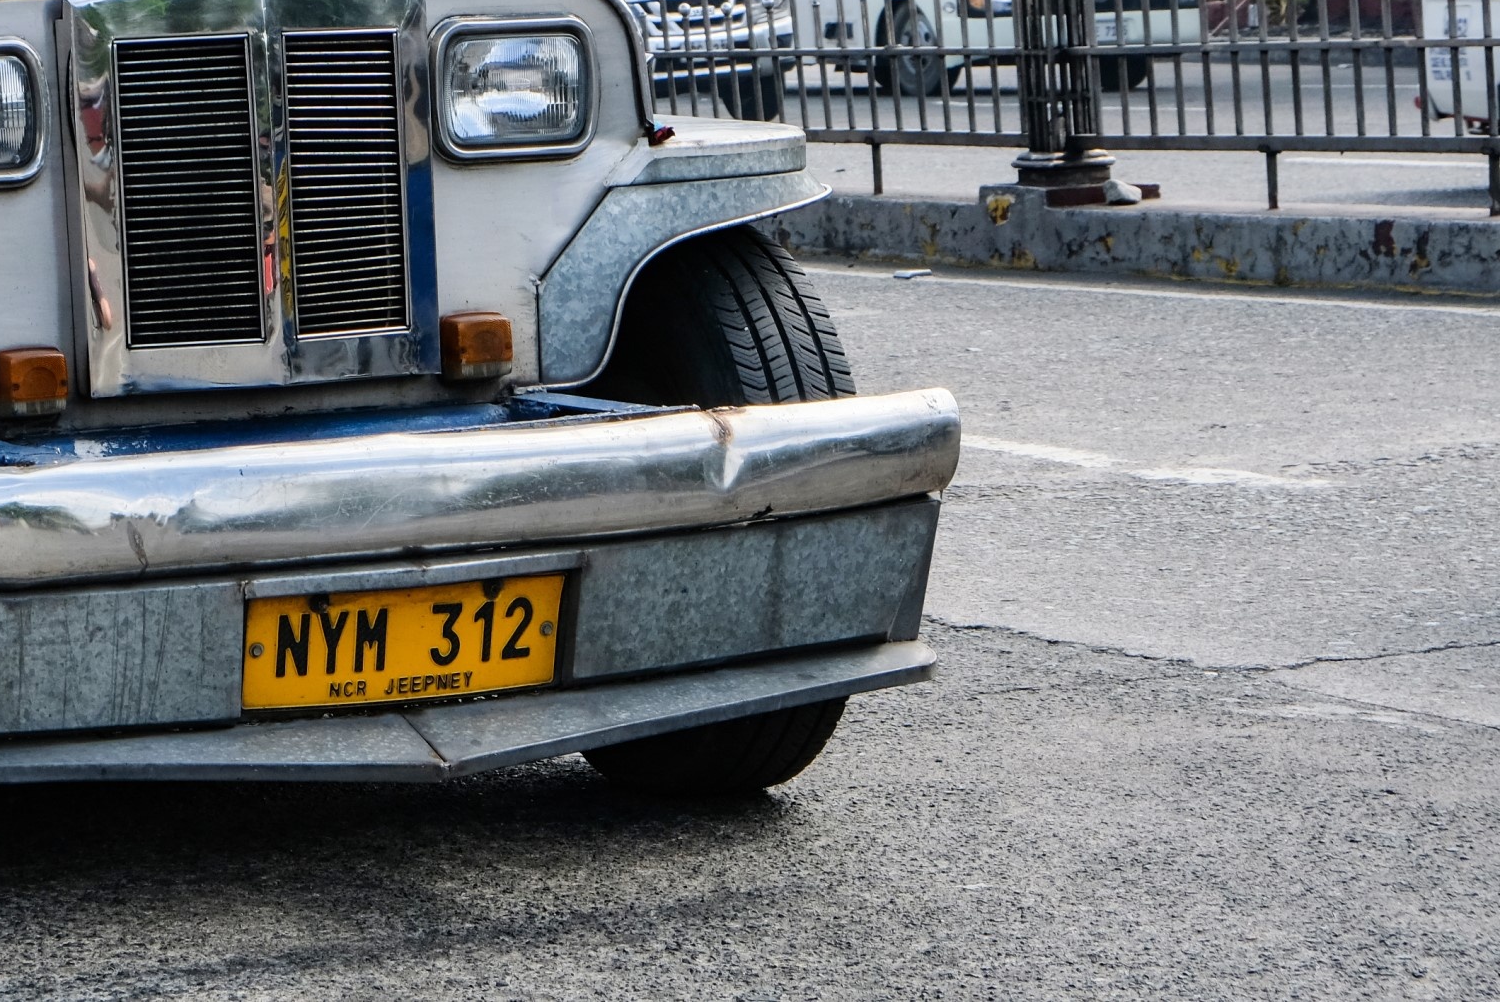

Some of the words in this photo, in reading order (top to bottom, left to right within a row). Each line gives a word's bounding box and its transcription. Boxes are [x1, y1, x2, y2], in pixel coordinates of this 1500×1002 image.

[275, 606, 389, 678] NYM
[429, 596, 534, 667] 312
[329, 681, 367, 698] NCR
[384, 670, 474, 695] JEEPNEY
